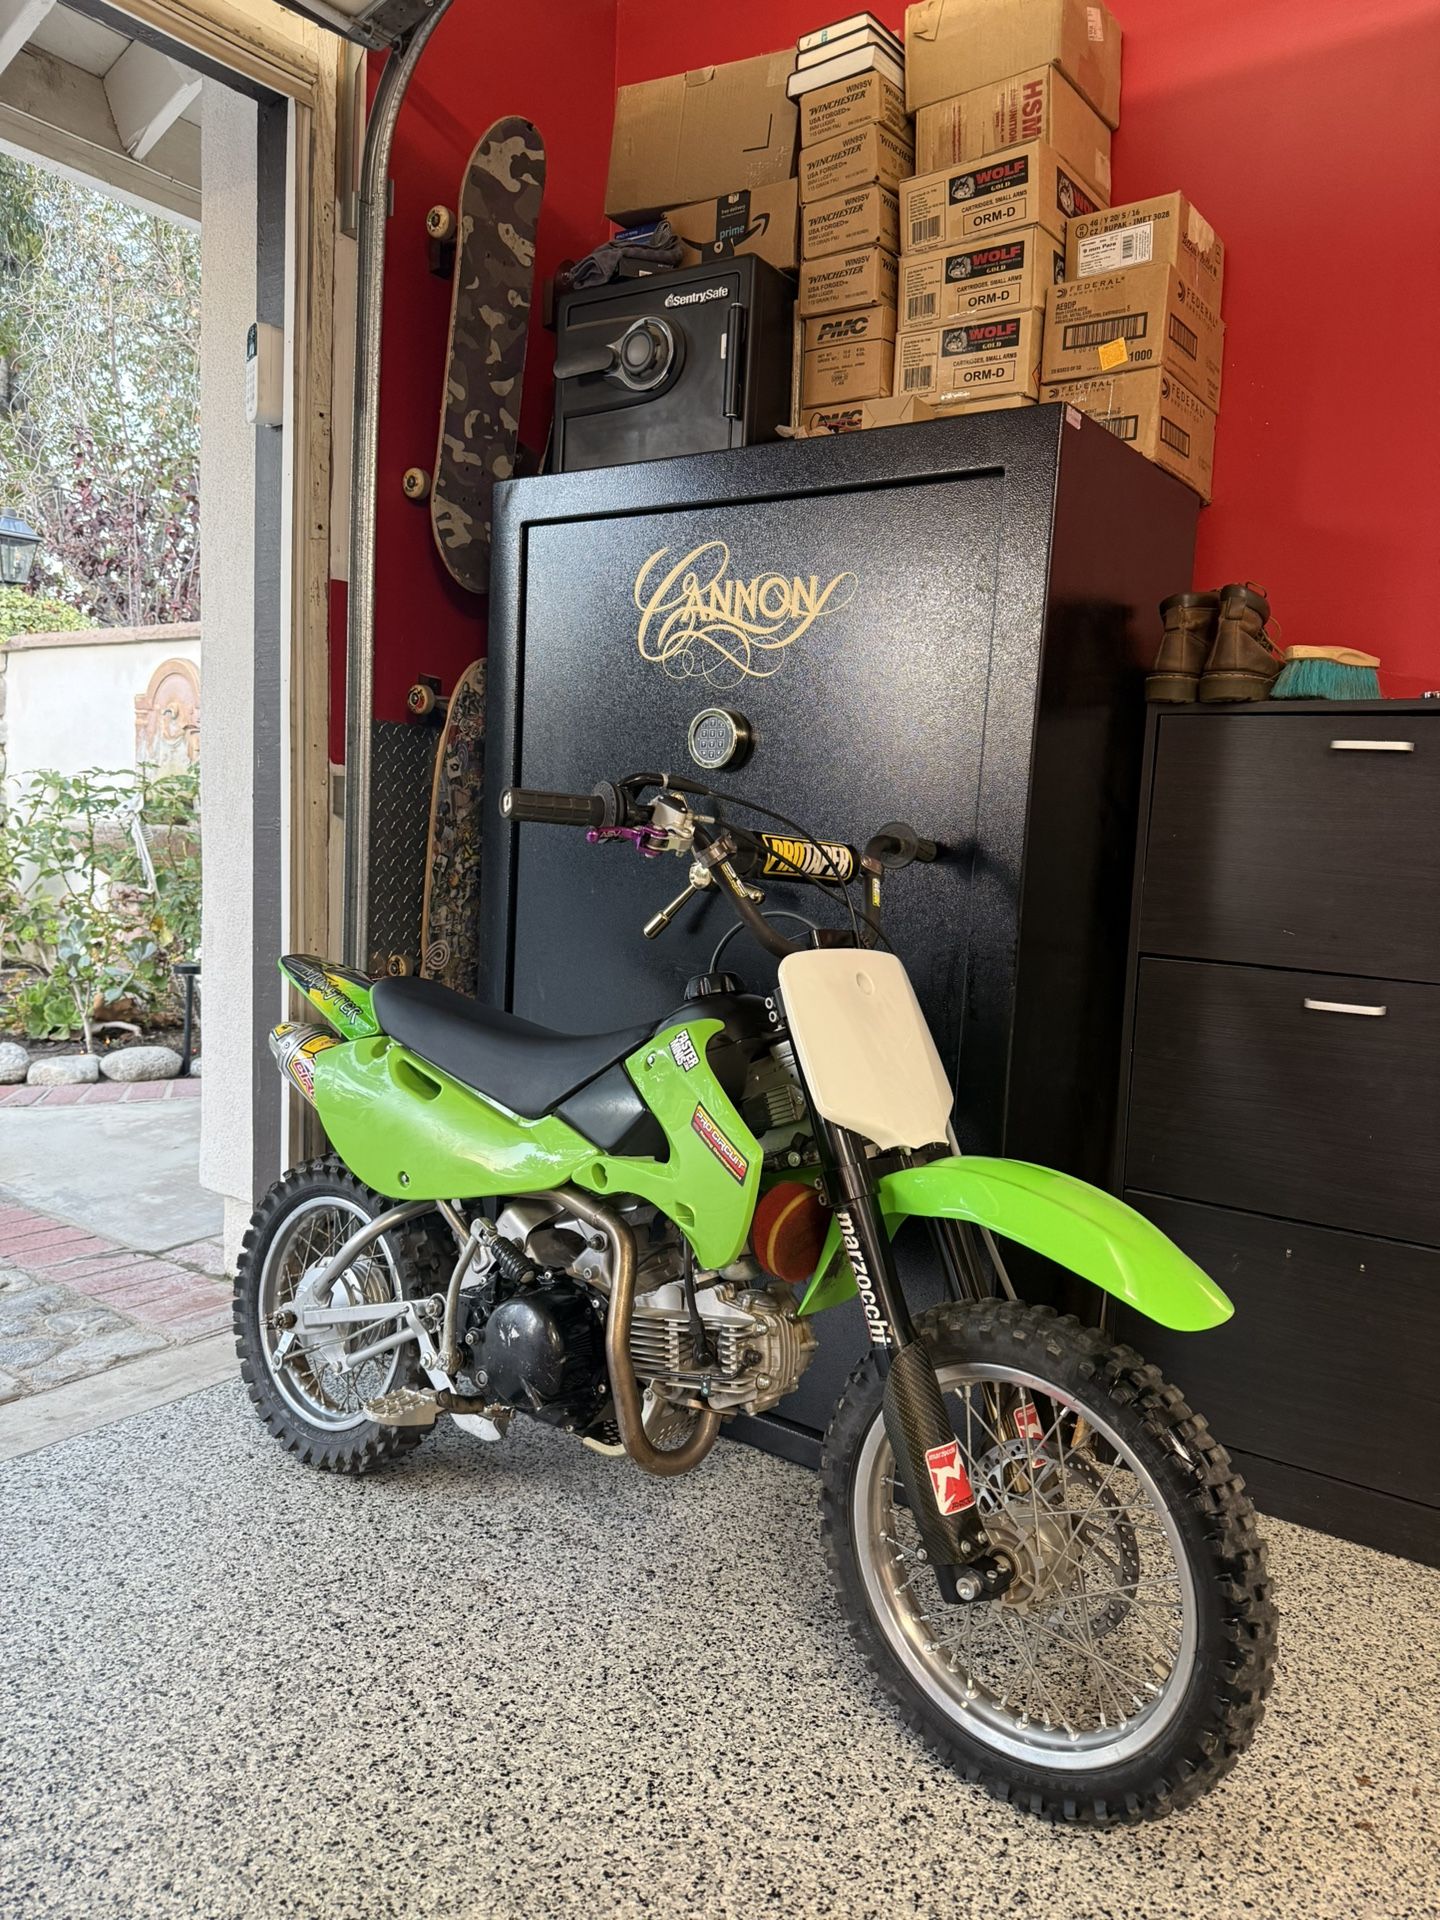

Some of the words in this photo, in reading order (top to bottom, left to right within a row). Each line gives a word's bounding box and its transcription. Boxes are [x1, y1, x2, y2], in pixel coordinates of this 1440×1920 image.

[809, 90, 866, 116] WINCHESTER
[1022, 79, 1043, 139] HSM
[807, 143, 863, 170] WINCHESTER
[975, 160, 1025, 185] WOLF
[990, 181, 1010, 192] GOLD
[808, 204, 864, 227] WINCHESTER
[973, 206, 1015, 226] ORM-D
[720, 225, 745, 240] prime
[1090, 228, 1099, 236] CZ
[972, 245, 1021, 266] WOLF
[808, 265, 863, 284] WINCHESTER
[987, 264, 1006, 274] GOLD
[1007, 274, 1022, 282] ARMS
[1069, 278, 1121, 293] FEDERAL
[673, 286, 728, 306] SentrySafe
[968, 290, 1010, 307] ORM-D
[817, 316, 868, 341] PMC
[969, 322, 1017, 340] WOLF
[982, 342, 1002, 350] GOLD
[1129, 349, 1152, 362] 1000
[985, 354, 1003, 362] SMALL
[964, 367, 1005, 382] ORM-D
[1062, 380, 1112, 393] FEDERAL
[635, 541, 858, 680] CANNON
[676, 1029, 699, 1067] FASTER
[697, 1111, 713, 1132] PRO
[711, 1131, 743, 1168] CIRCUIT
[837, 1212, 892, 1345] marzocchi
